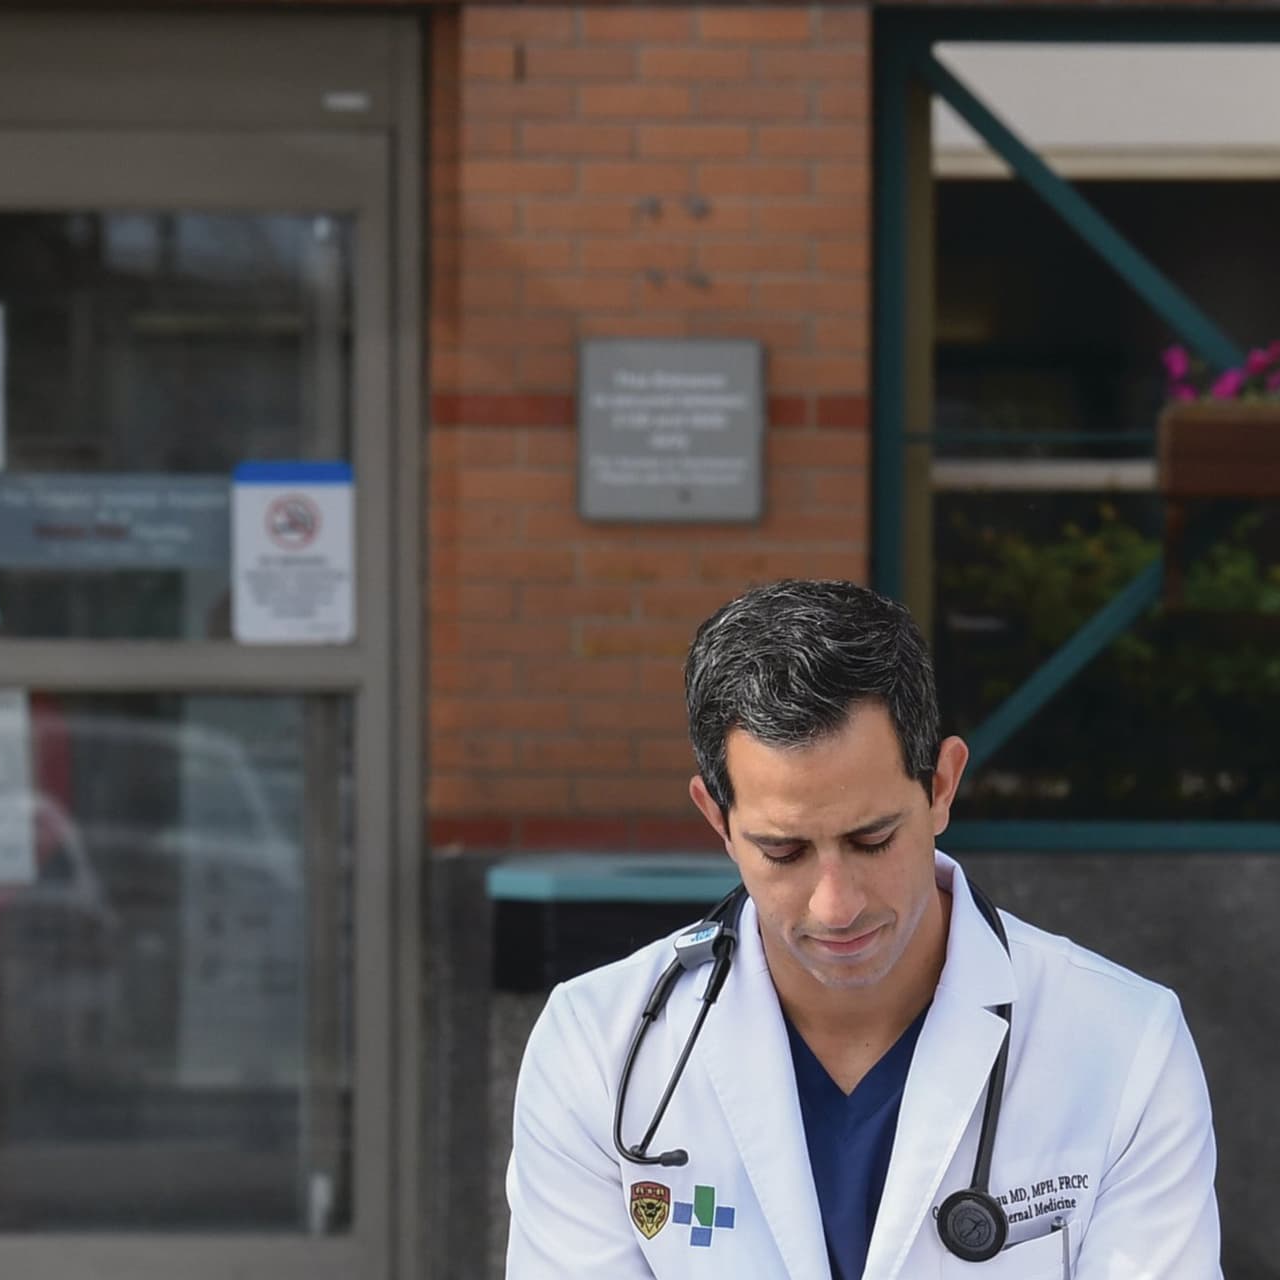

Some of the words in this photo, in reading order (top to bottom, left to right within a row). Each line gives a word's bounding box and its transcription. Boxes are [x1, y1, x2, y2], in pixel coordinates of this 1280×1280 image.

[1009, 1187, 1030, 1204] MD,
[1031, 1179, 1057, 1199] MPH,
[1058, 1174, 1088, 1190] FRCPC
[1008, 1204, 1033, 1224] ernal
[1034, 1196, 1077, 1217] Medicine
